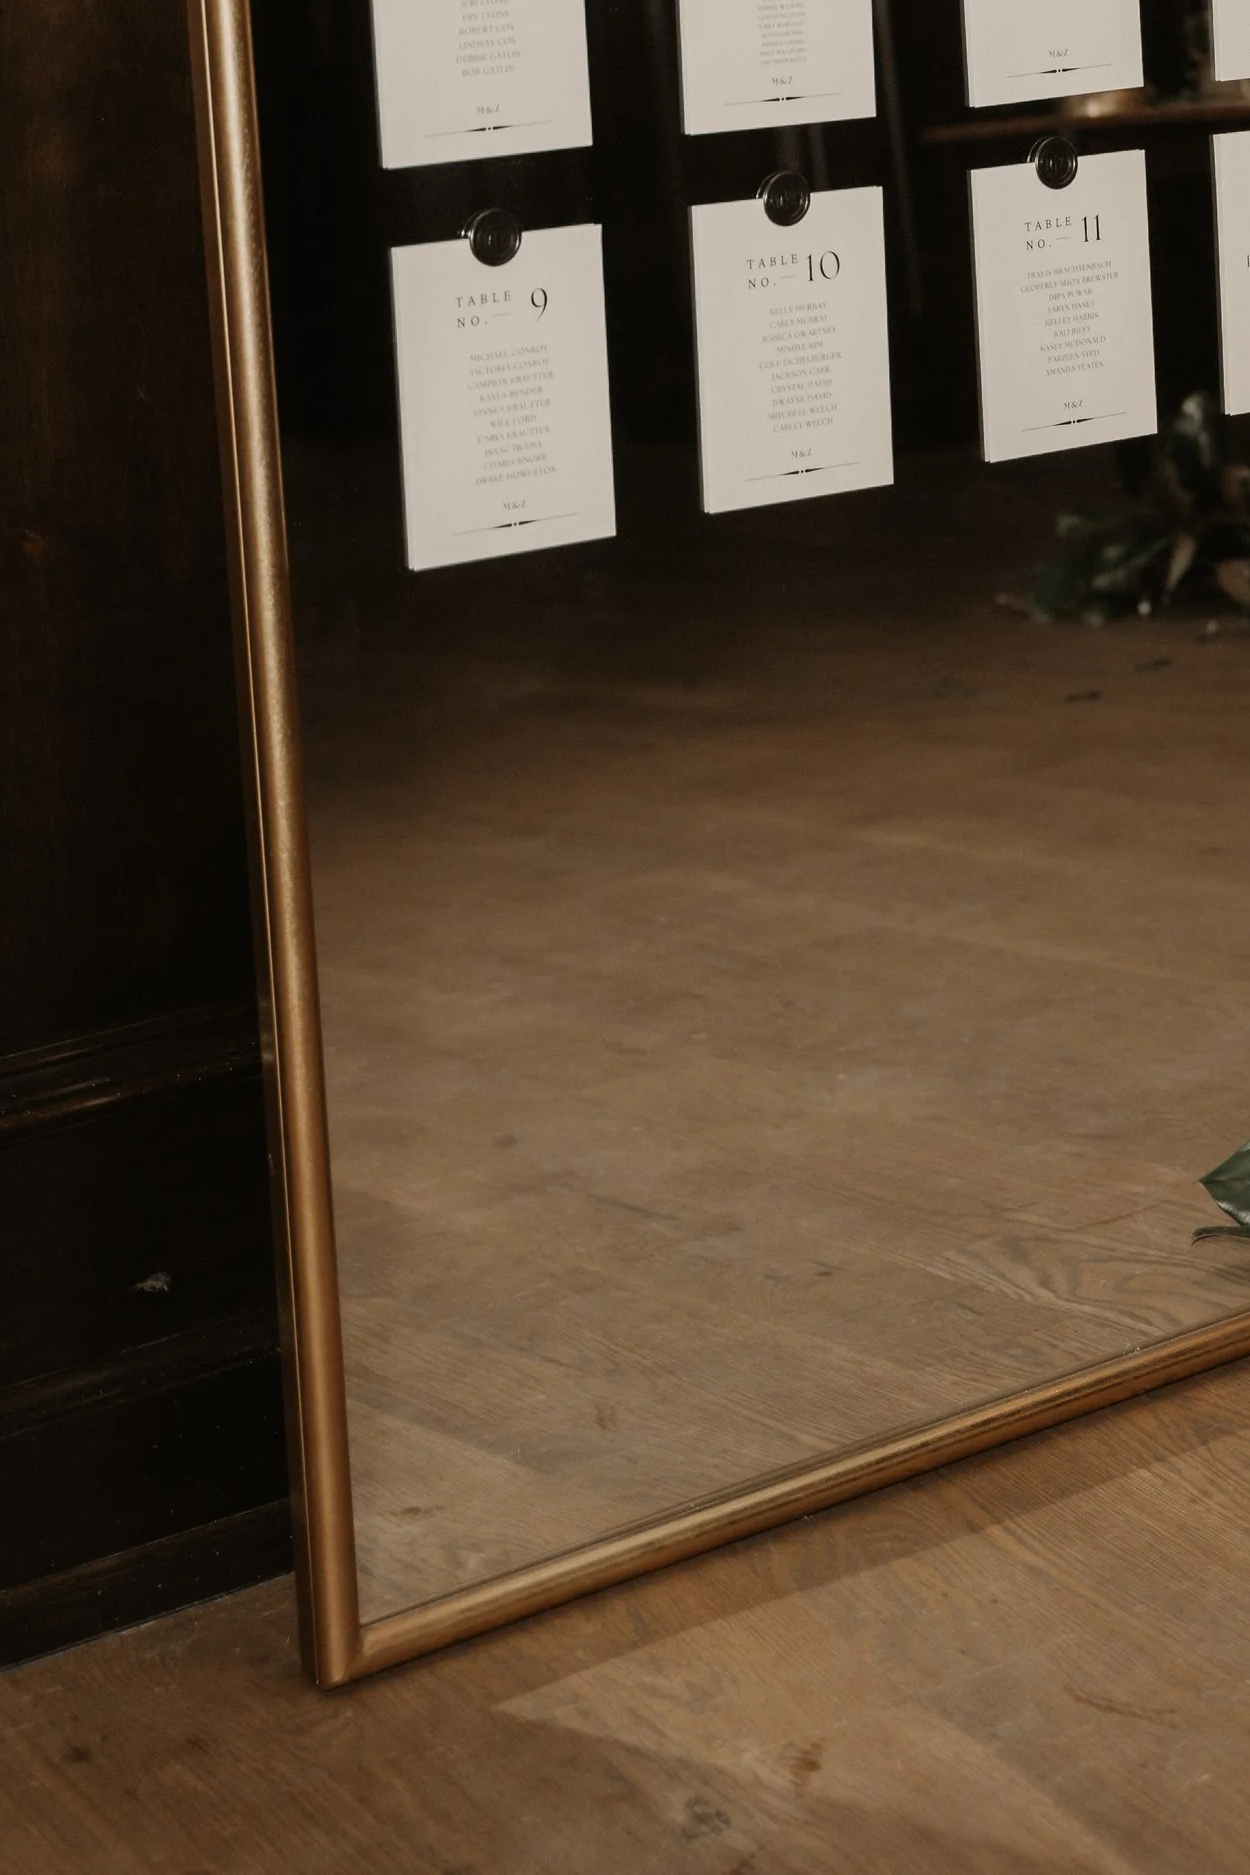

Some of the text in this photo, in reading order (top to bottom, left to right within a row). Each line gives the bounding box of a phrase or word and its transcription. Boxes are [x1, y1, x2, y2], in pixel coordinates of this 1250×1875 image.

[1025, 216, 1071, 231] TABLE
[1082, 215, 1100, 242] 11
[747, 254, 798, 269] TABLE
[808, 251, 840, 281] 10
[456, 291, 510, 308] TABLE
[531, 288, 547, 321] 9
